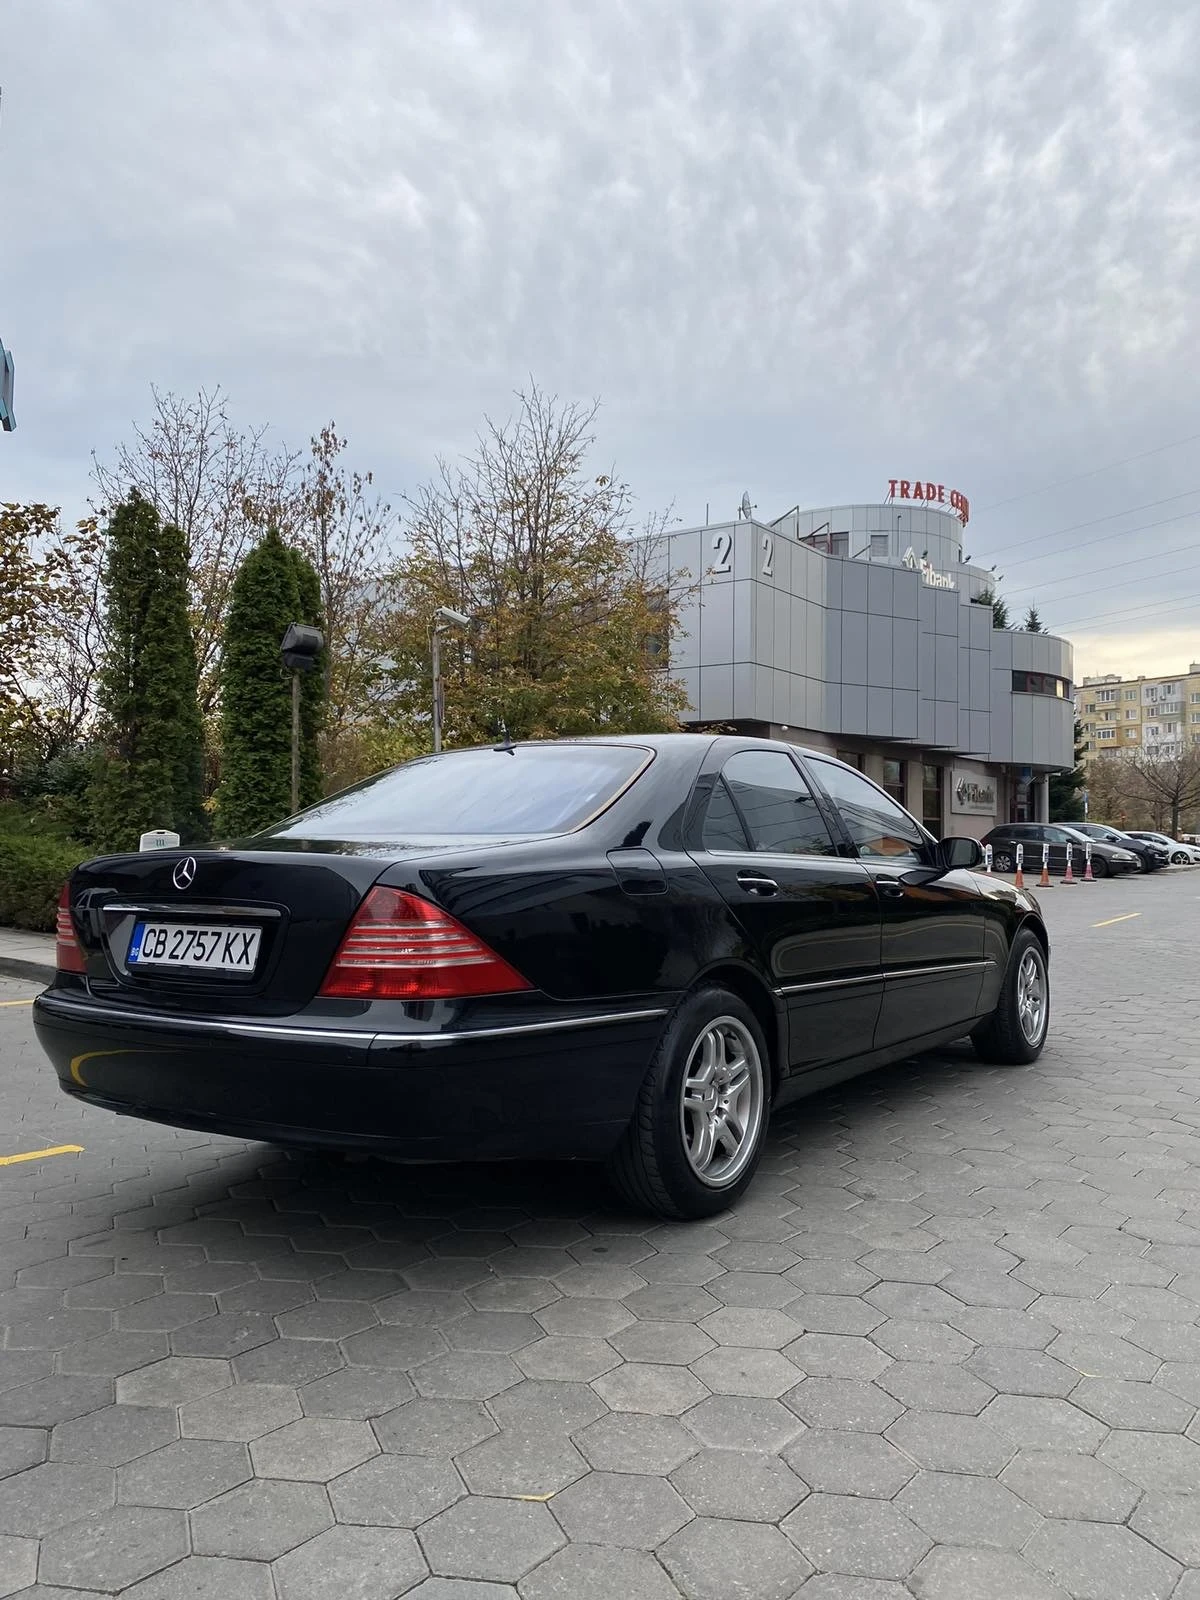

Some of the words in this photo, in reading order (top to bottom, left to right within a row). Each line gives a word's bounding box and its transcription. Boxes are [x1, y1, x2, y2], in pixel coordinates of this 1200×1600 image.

[888, 479, 945, 503] TRADE
[711, 532, 732, 574] 2
[762, 534, 774, 577] 2
[142, 928, 168, 958] CB
[168, 929, 222, 962] 2757
[221, 931, 256, 965] KX
